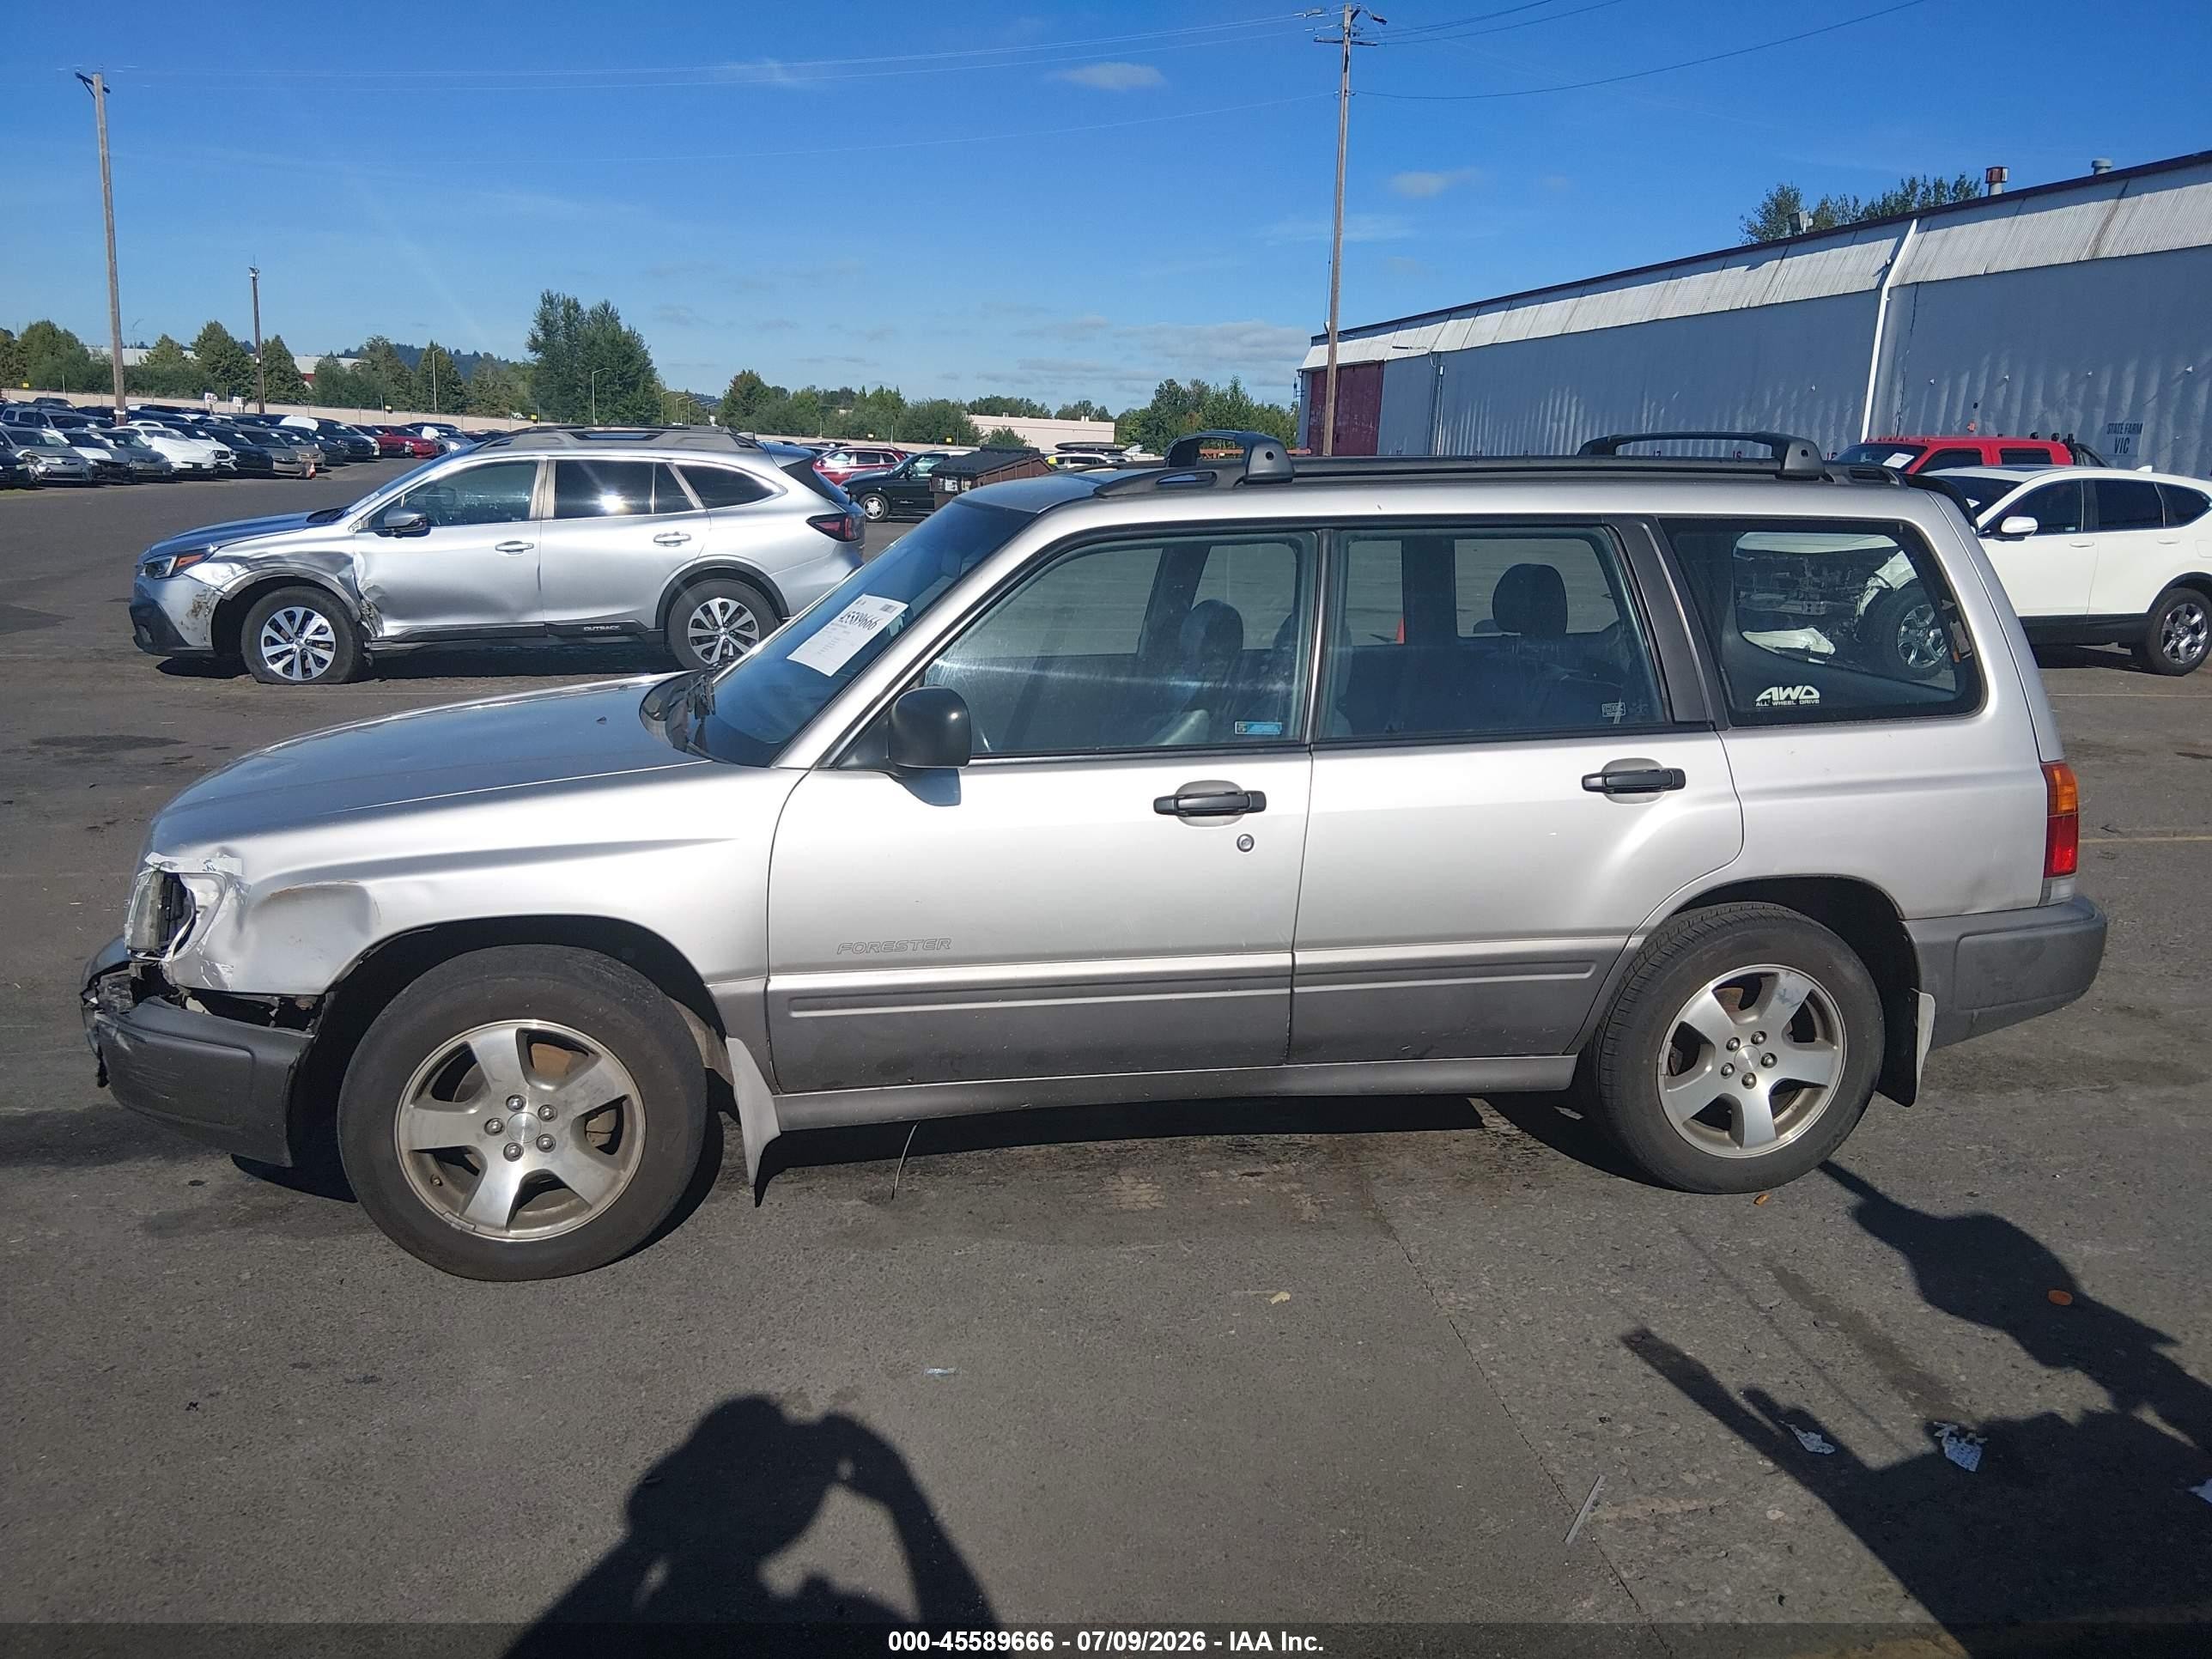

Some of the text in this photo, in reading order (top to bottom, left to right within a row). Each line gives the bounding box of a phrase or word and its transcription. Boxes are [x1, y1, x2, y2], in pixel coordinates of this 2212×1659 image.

[2106, 422, 2143, 434] STATE FARM
[2114, 437, 2130, 453] VIC
[1755, 685, 1820, 702] AWD
[836, 938, 952, 955] FORESTER
